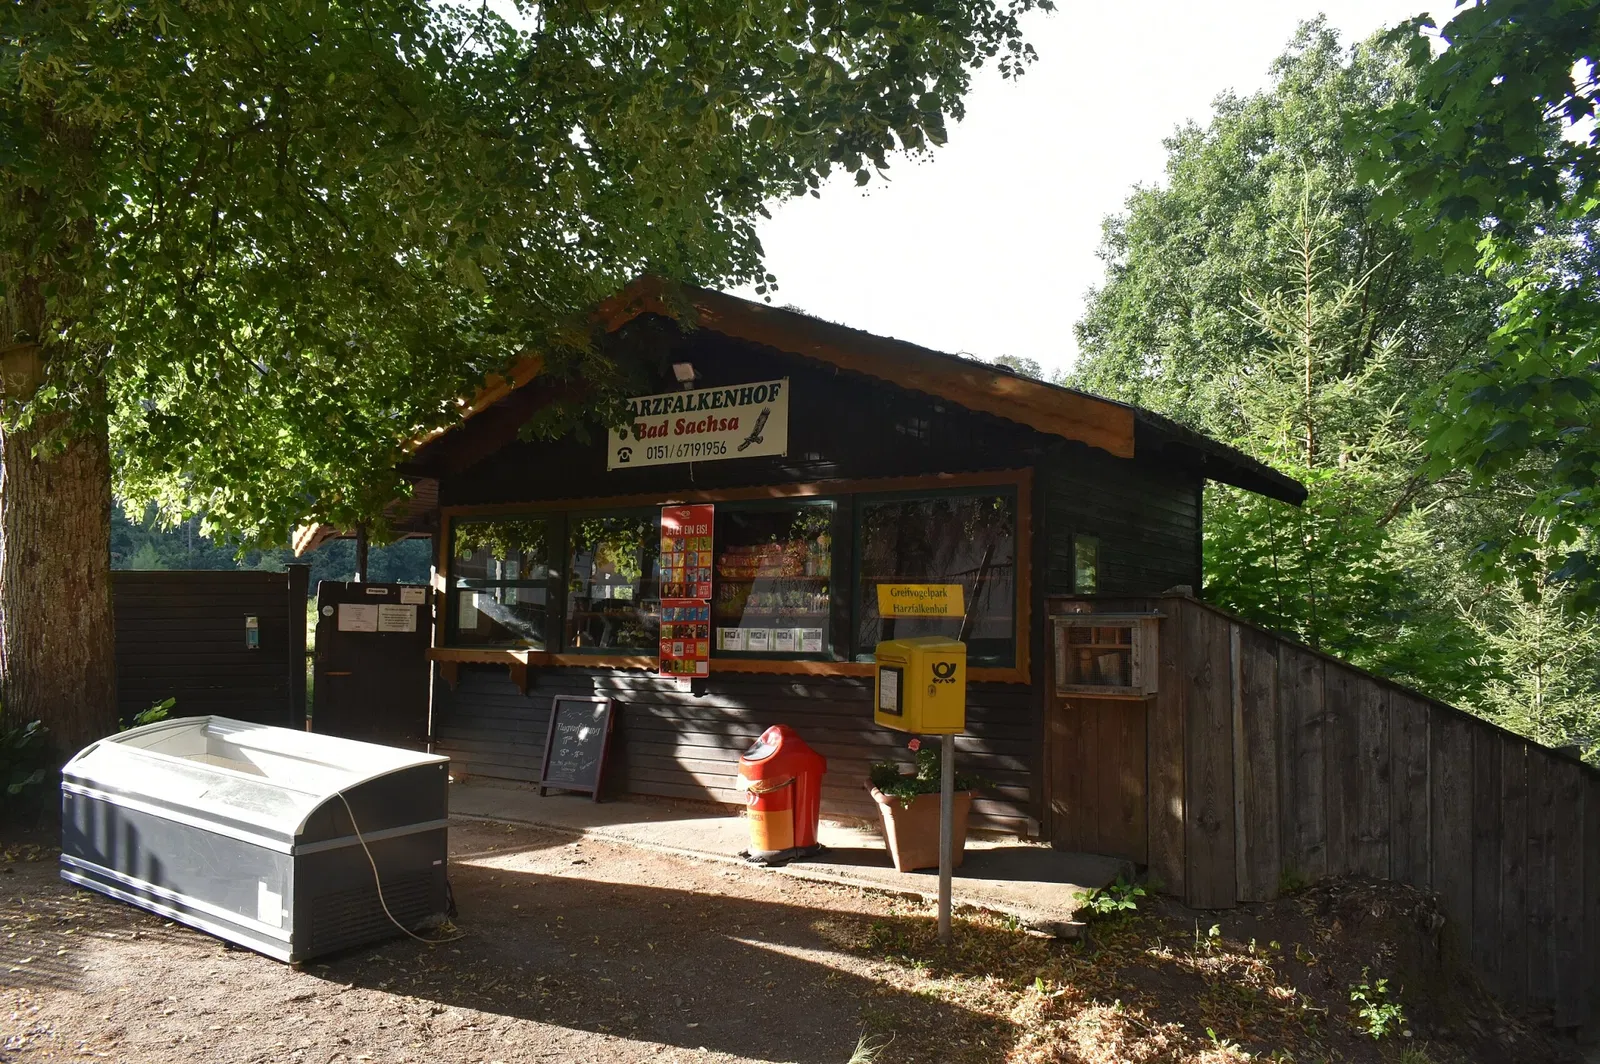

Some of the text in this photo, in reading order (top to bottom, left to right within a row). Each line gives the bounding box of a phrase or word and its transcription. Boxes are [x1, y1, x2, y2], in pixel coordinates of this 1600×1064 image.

[629, 383, 782, 417] ARZFALKENHOF
[636, 415, 740, 440] Bad Sachsa
[646, 440, 727, 460] 0151/67191956
[665, 523, 708, 536] JETZT EIN EIS!
[890, 587, 948, 600] Greifvogelpark
[893, 603, 948, 614] Harzfalkenhof
